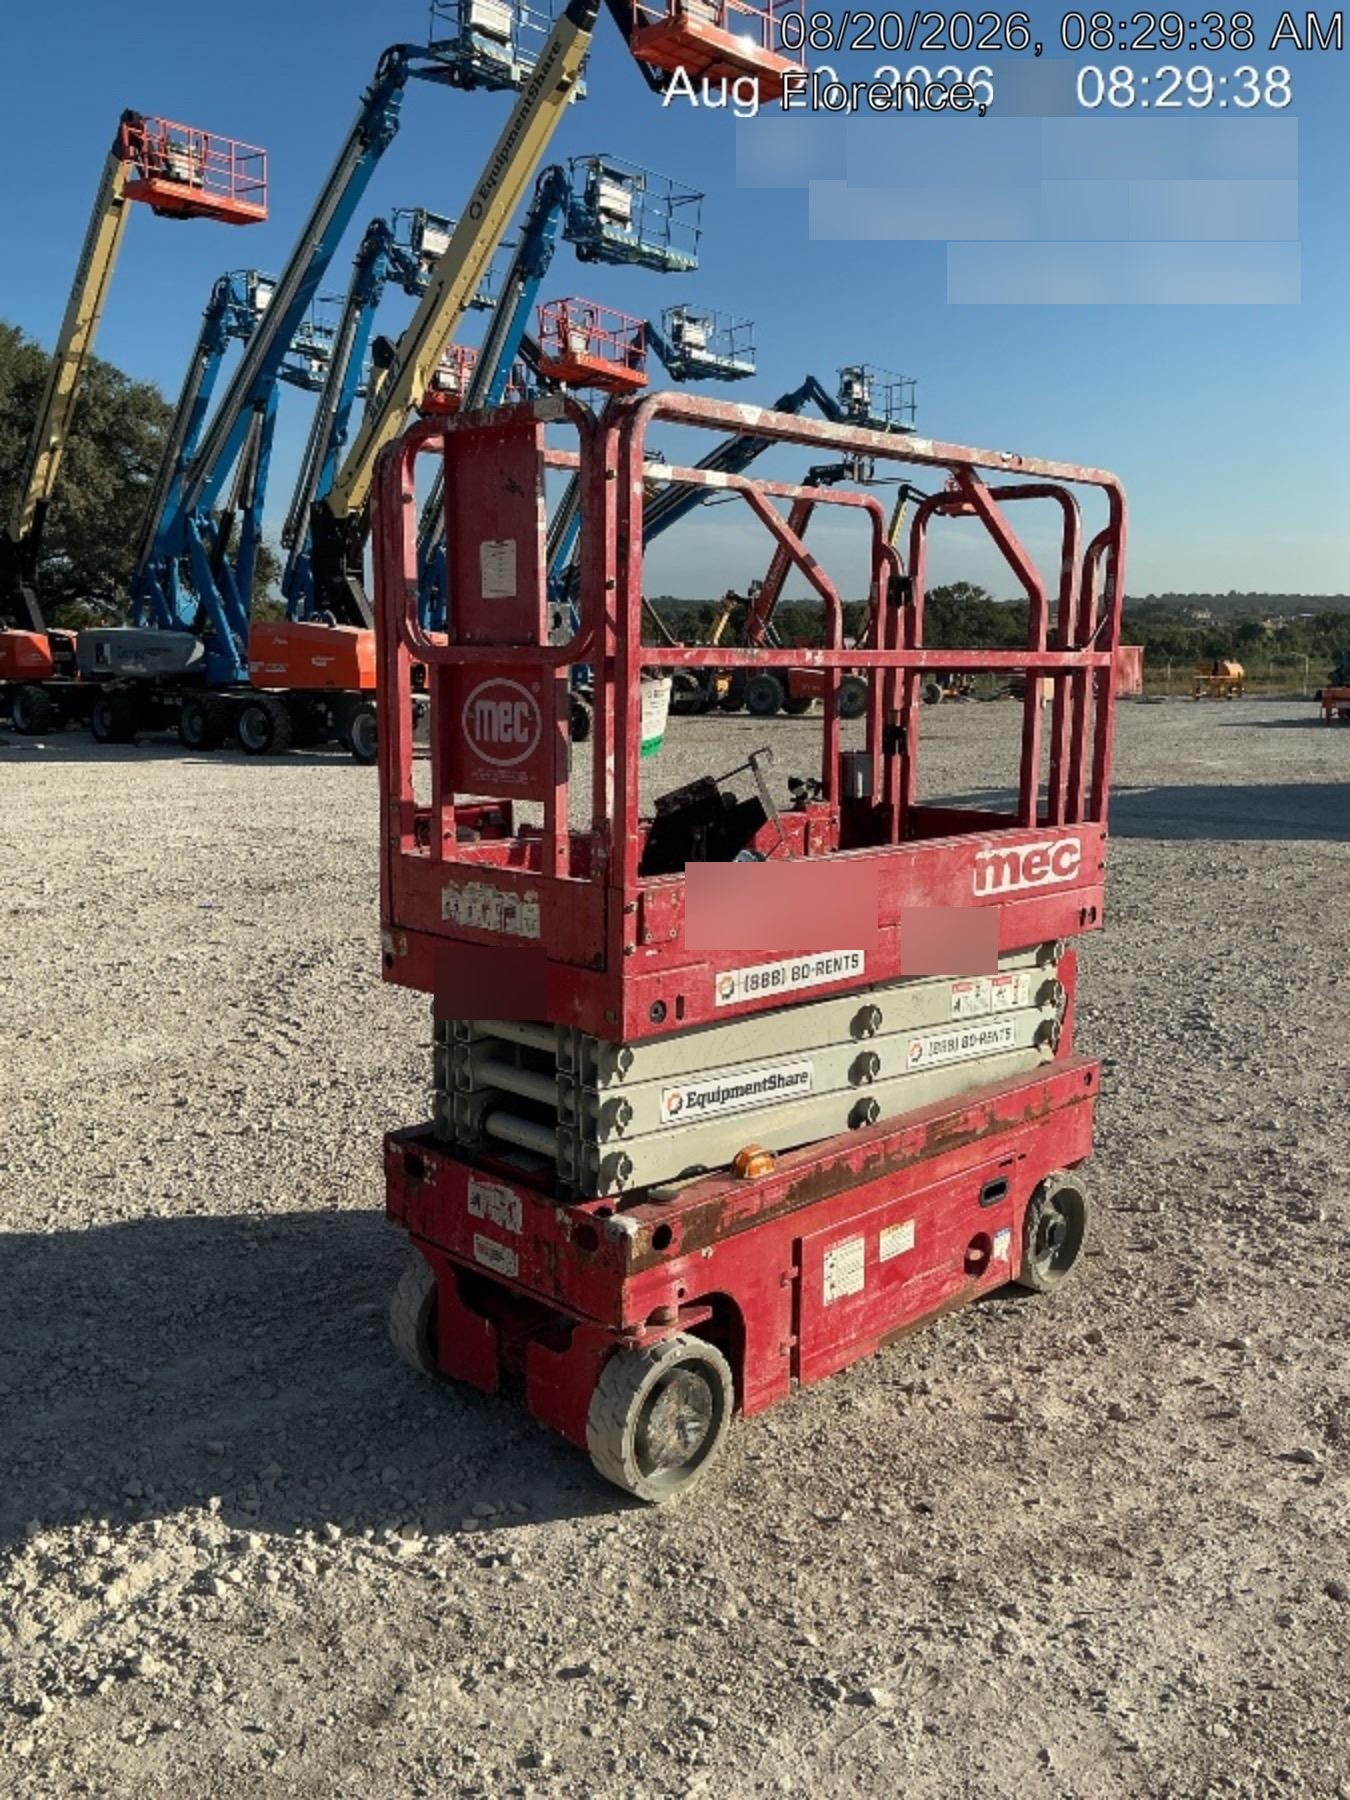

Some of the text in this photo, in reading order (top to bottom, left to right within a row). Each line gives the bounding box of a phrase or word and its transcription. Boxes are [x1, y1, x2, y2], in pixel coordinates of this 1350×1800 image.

[478, 40, 563, 201] EquipmentShare
[974, 843, 1081, 892] mec
[685, 1070, 809, 1110] EquipmentShare
